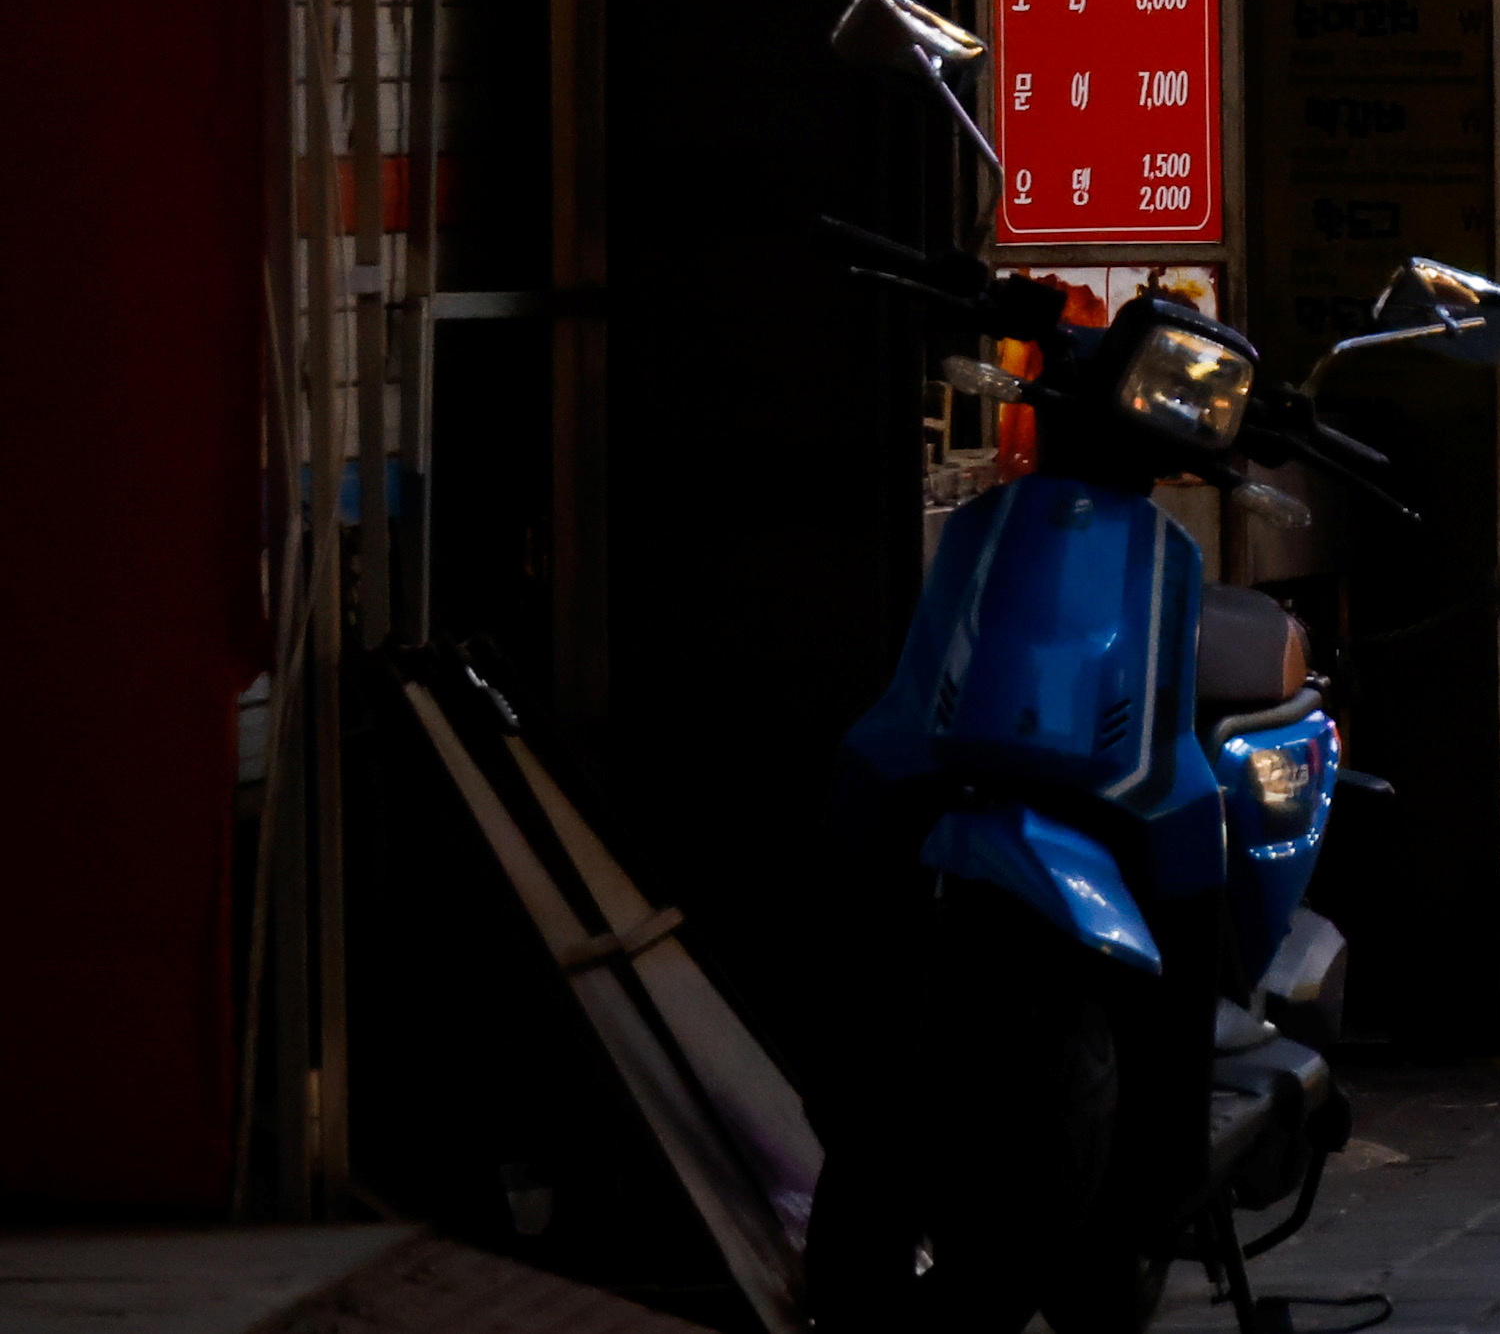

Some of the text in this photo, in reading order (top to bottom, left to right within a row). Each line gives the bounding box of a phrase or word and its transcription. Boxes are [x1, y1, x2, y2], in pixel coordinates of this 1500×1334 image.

[1137, 72, 1189, 108] 7,000
[1140, 153, 1191, 181] 1,500
[1138, 185, 1192, 213] 2,000
